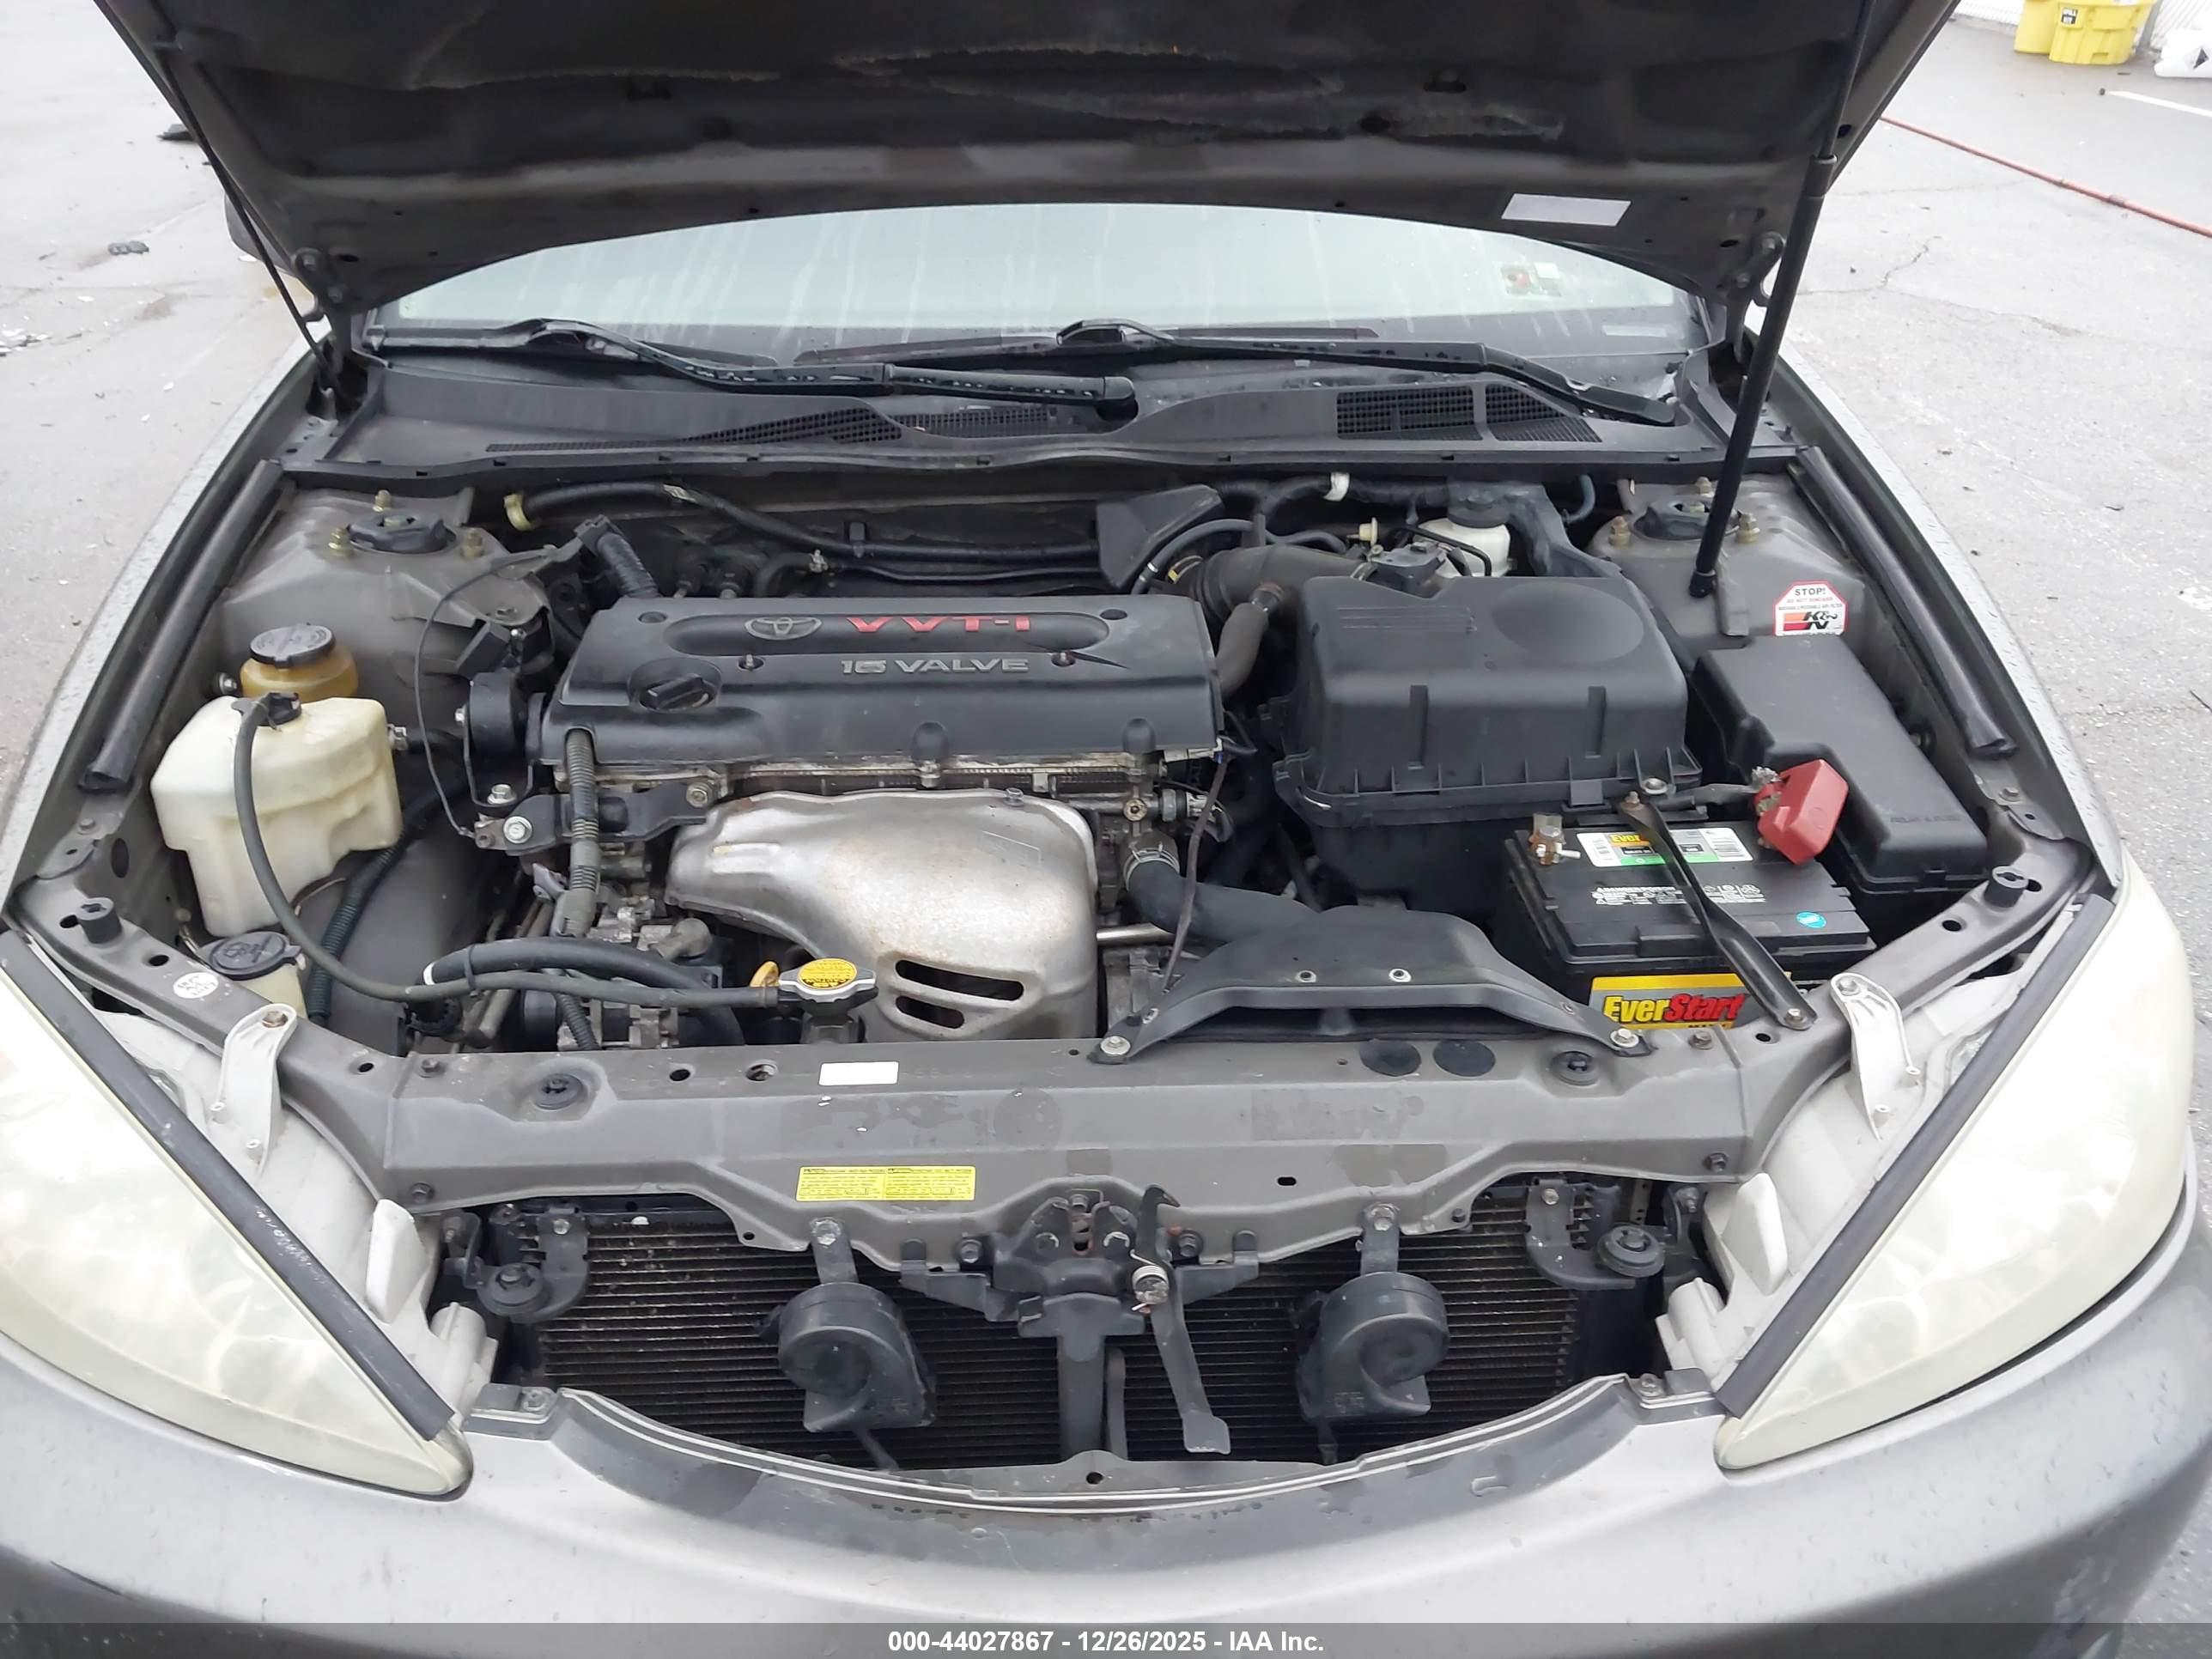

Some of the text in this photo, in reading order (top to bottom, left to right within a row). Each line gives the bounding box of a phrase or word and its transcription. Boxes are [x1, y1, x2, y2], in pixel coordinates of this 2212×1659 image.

[1795, 587, 1826, 596] STOP!
[841, 659, 1030, 674] 16 VALVE
[1603, 993, 1746, 1024] EverStart
